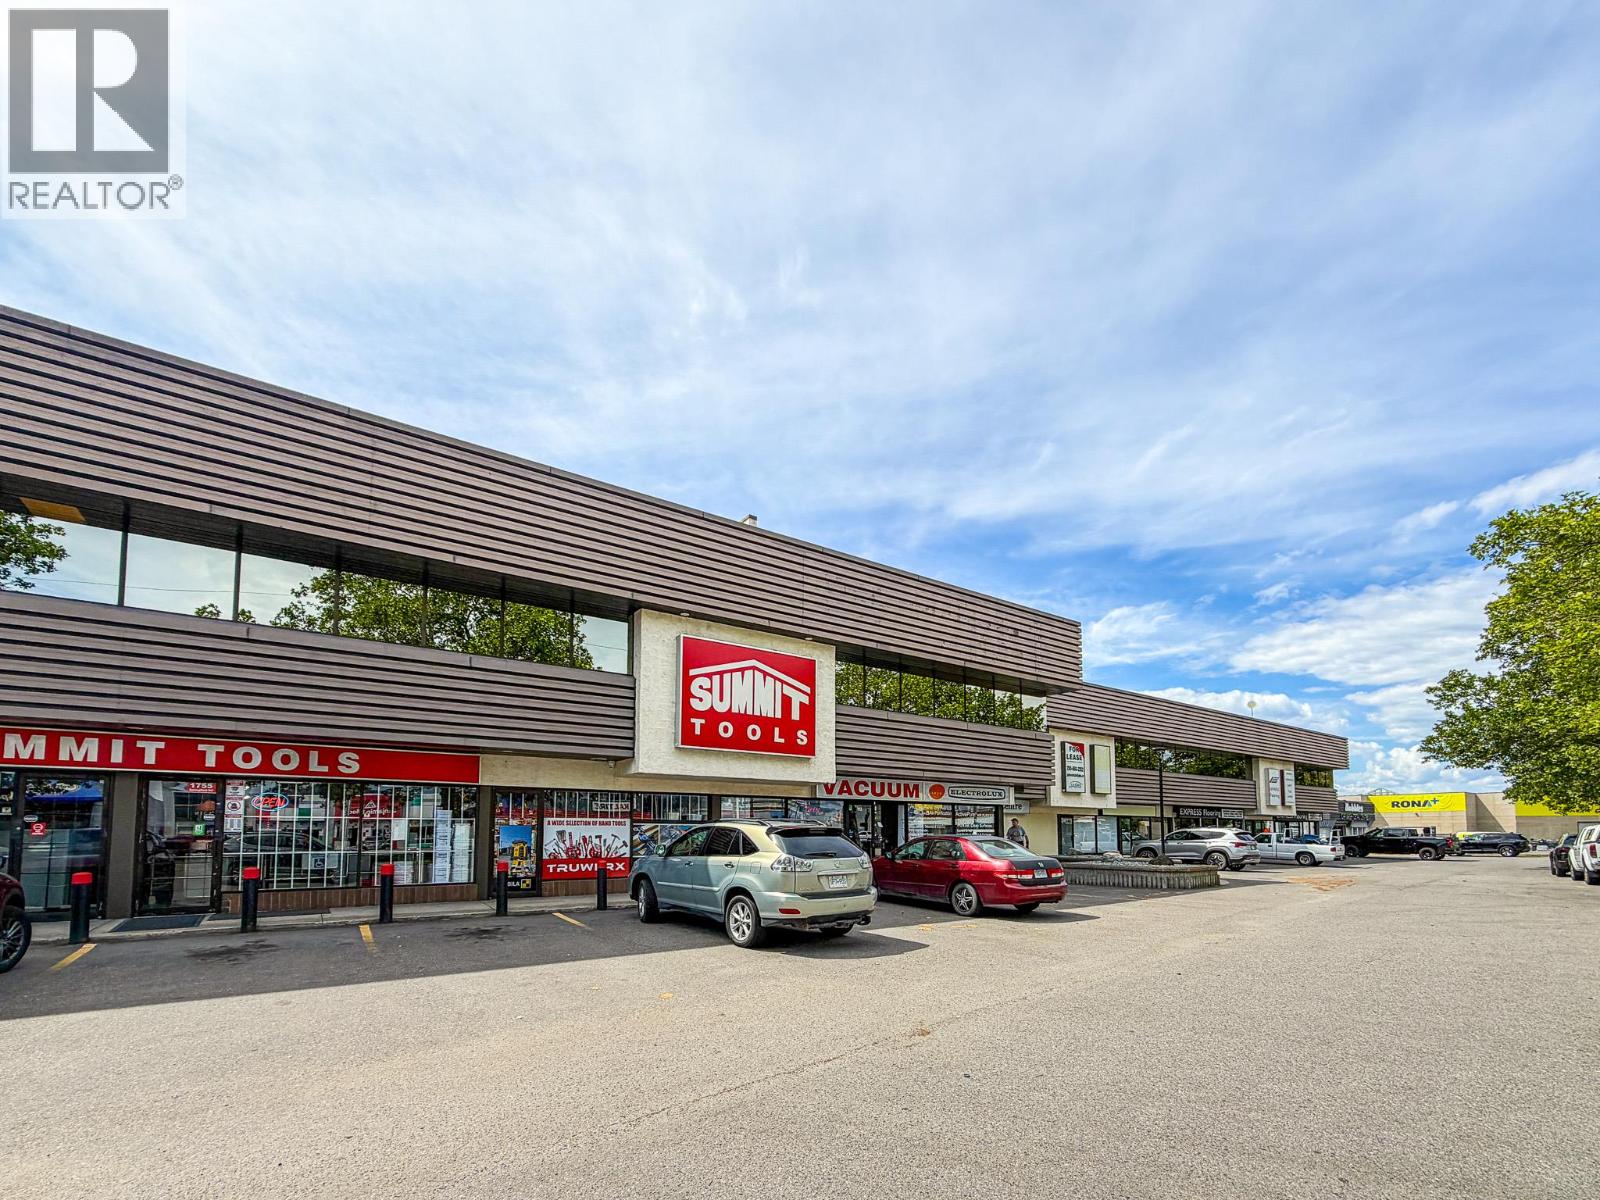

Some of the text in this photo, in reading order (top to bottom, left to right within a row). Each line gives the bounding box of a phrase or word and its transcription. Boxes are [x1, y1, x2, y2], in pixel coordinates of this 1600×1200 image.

[689, 669, 810, 721] SUMMIT
[690, 718, 808, 746] TOOLS
[2, 733, 361, 774] MMIT TOOLS
[823, 779, 920, 799] VACUUM
[950, 789, 1003, 798] ELECTROLUX
[253, 796, 286, 807] OPEN
[1179, 808, 1202, 816] EXPRESS
[547, 862, 625, 873] TRUWRX
